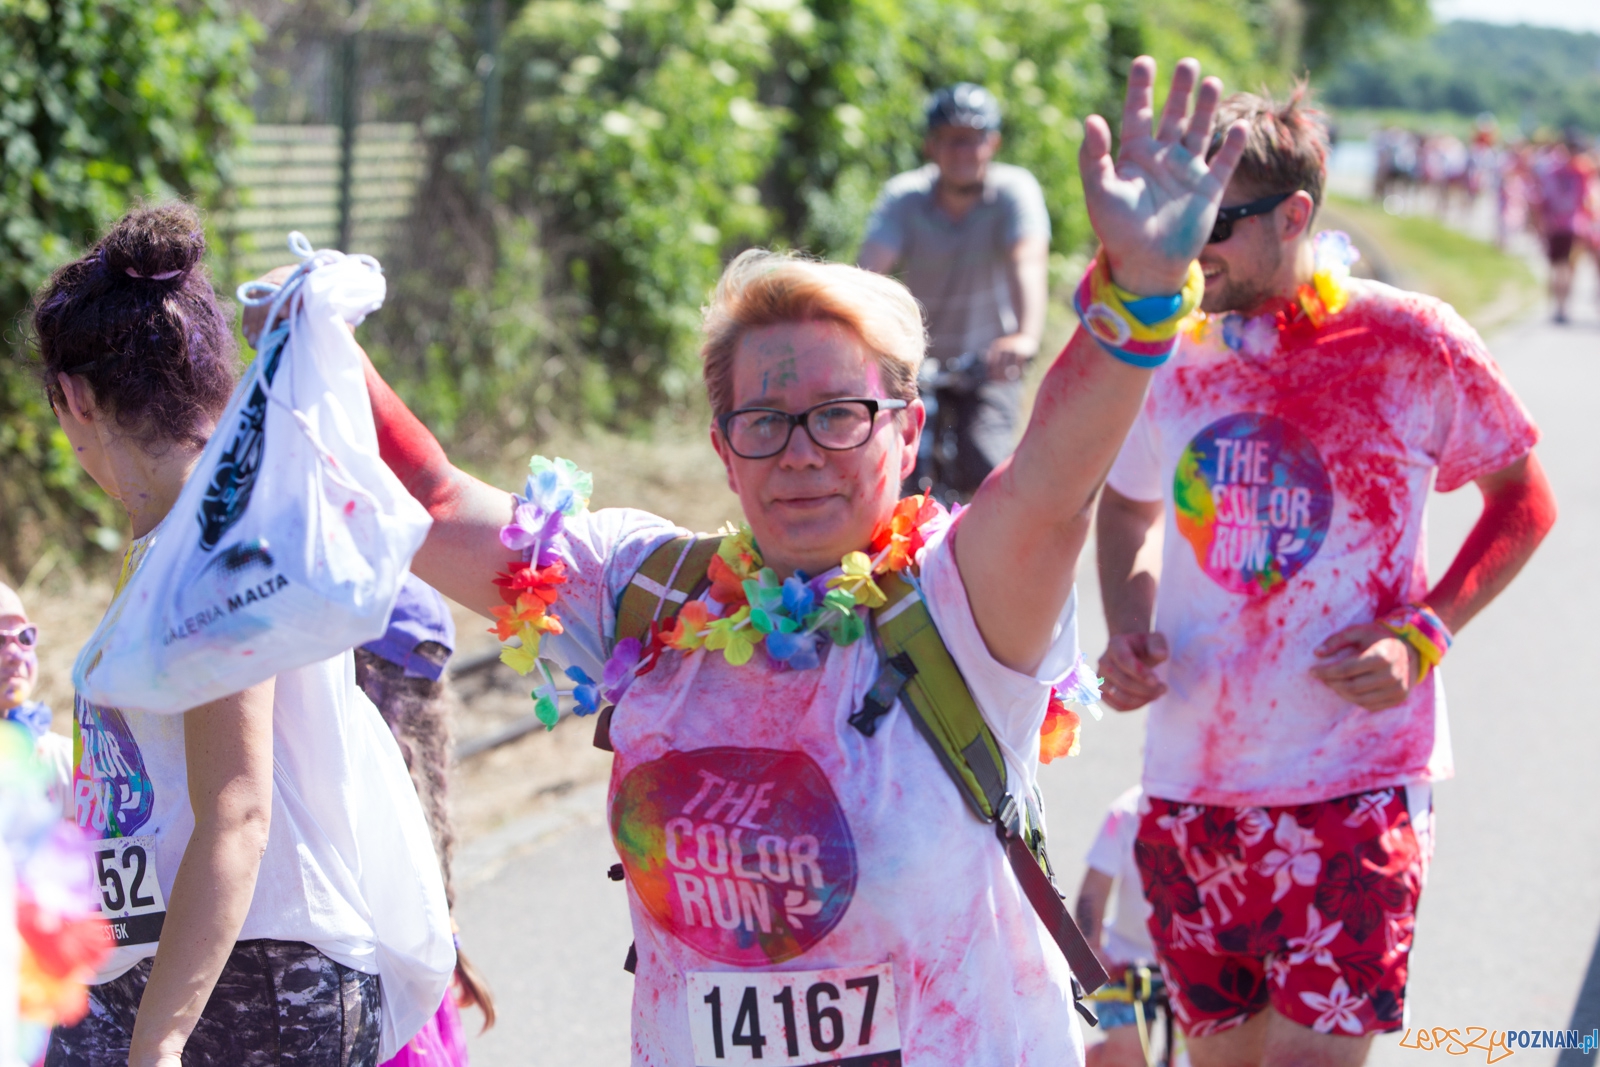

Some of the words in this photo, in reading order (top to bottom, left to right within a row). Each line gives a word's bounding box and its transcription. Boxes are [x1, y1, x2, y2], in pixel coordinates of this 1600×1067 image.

[1214, 438, 1270, 484] THE
[1211, 483, 1312, 530] COLOR
[1211, 525, 1270, 571] RUN
[227, 573, 289, 614] MALTA
[681, 768, 776, 831] THE
[91, 845, 155, 912] 52
[664, 816, 825, 889] COLOR
[673, 871, 773, 935] RUN
[703, 975, 880, 1060] 14167
